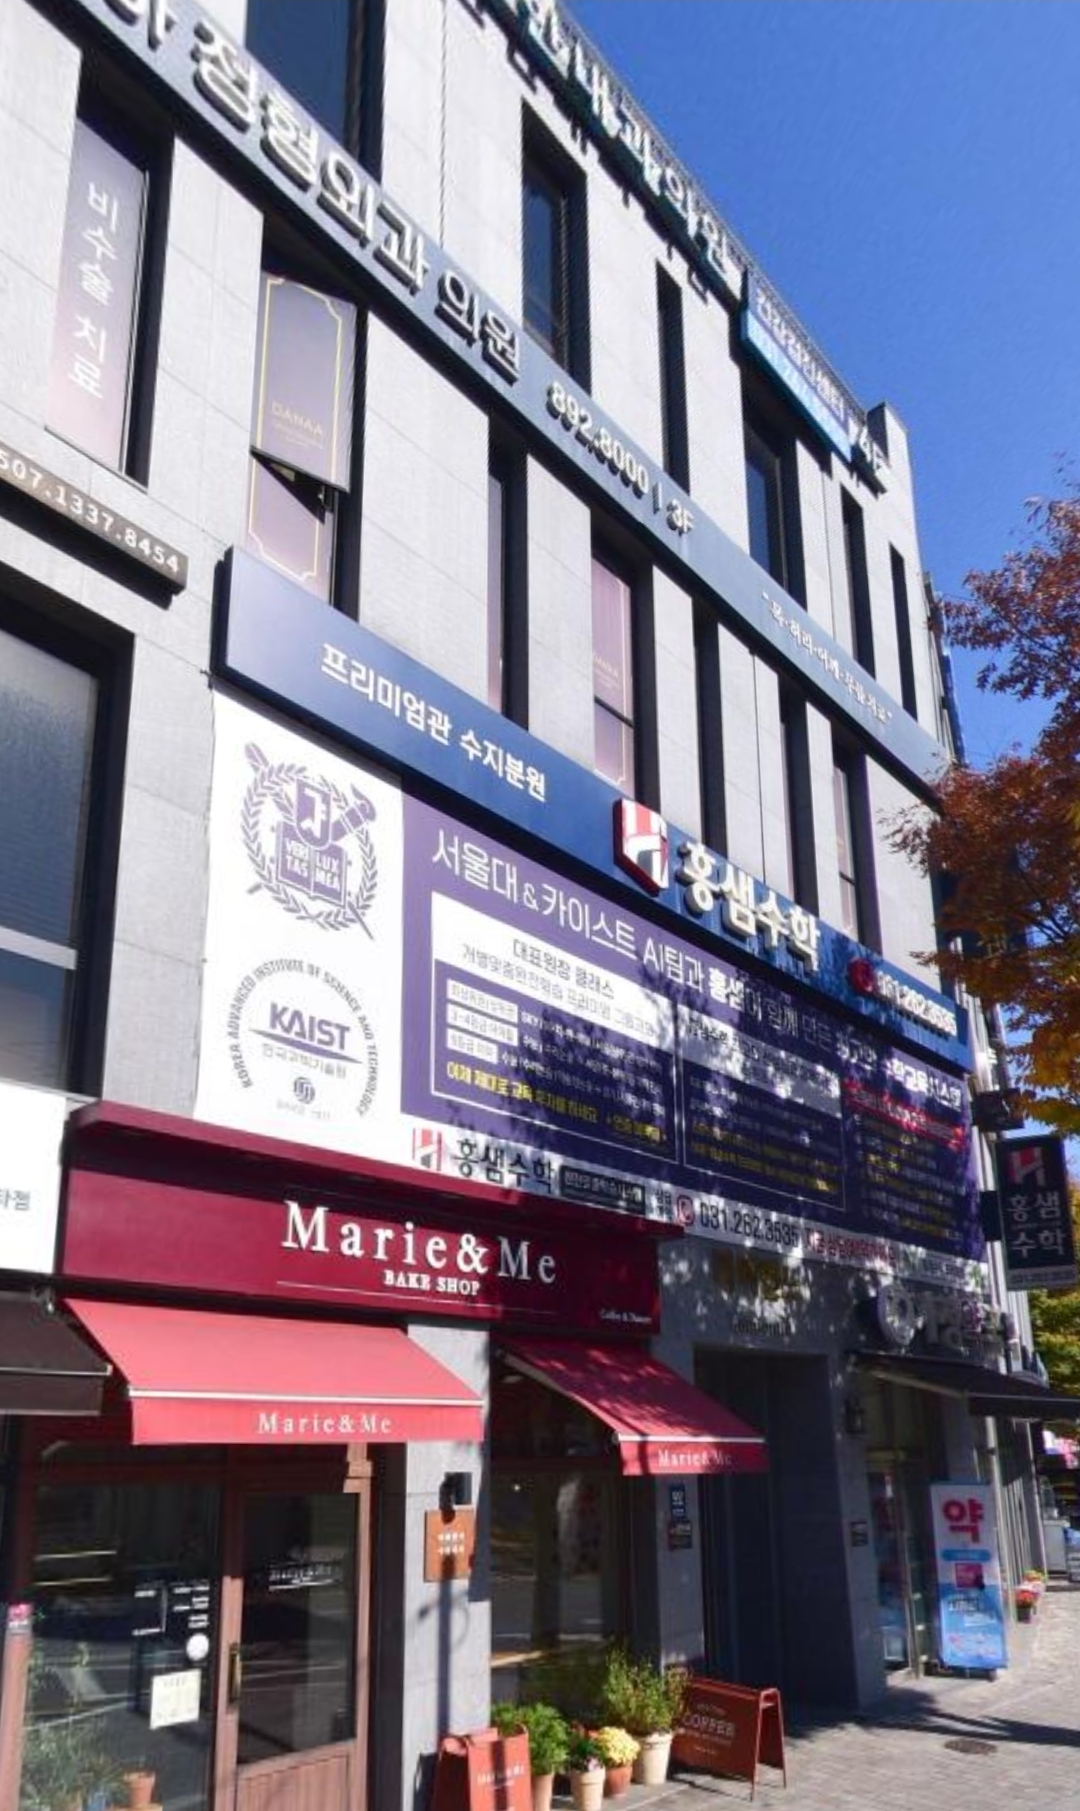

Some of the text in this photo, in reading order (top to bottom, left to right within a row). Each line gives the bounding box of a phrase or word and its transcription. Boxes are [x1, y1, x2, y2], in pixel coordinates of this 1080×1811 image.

[195, 22, 520, 386] 정형외과 의원
[67, 182, 118, 400] 비수술 치료
[549, 378, 650, 496] 892.8000
[321, 643, 546, 803] 프리미엄관 수지분원
[432, 829, 517, 904] 서울대
[542, 884, 637, 960] 카이스트
[643, 936, 705, 993] AI팀과
[678, 840, 820, 971] 홍샘수학
[269, 1001, 350, 1051] KAIST
[451, 1136, 556, 1189] 홍샘수학
[699, 1201, 800, 1248] 031.262.3535
[1006, 1191, 1061, 1222] 홍샘
[1011, 1229, 1066, 1258] 수학
[384, 1269, 480, 1297] BAKE SHOP
[942, 1497, 985, 1543] 약
